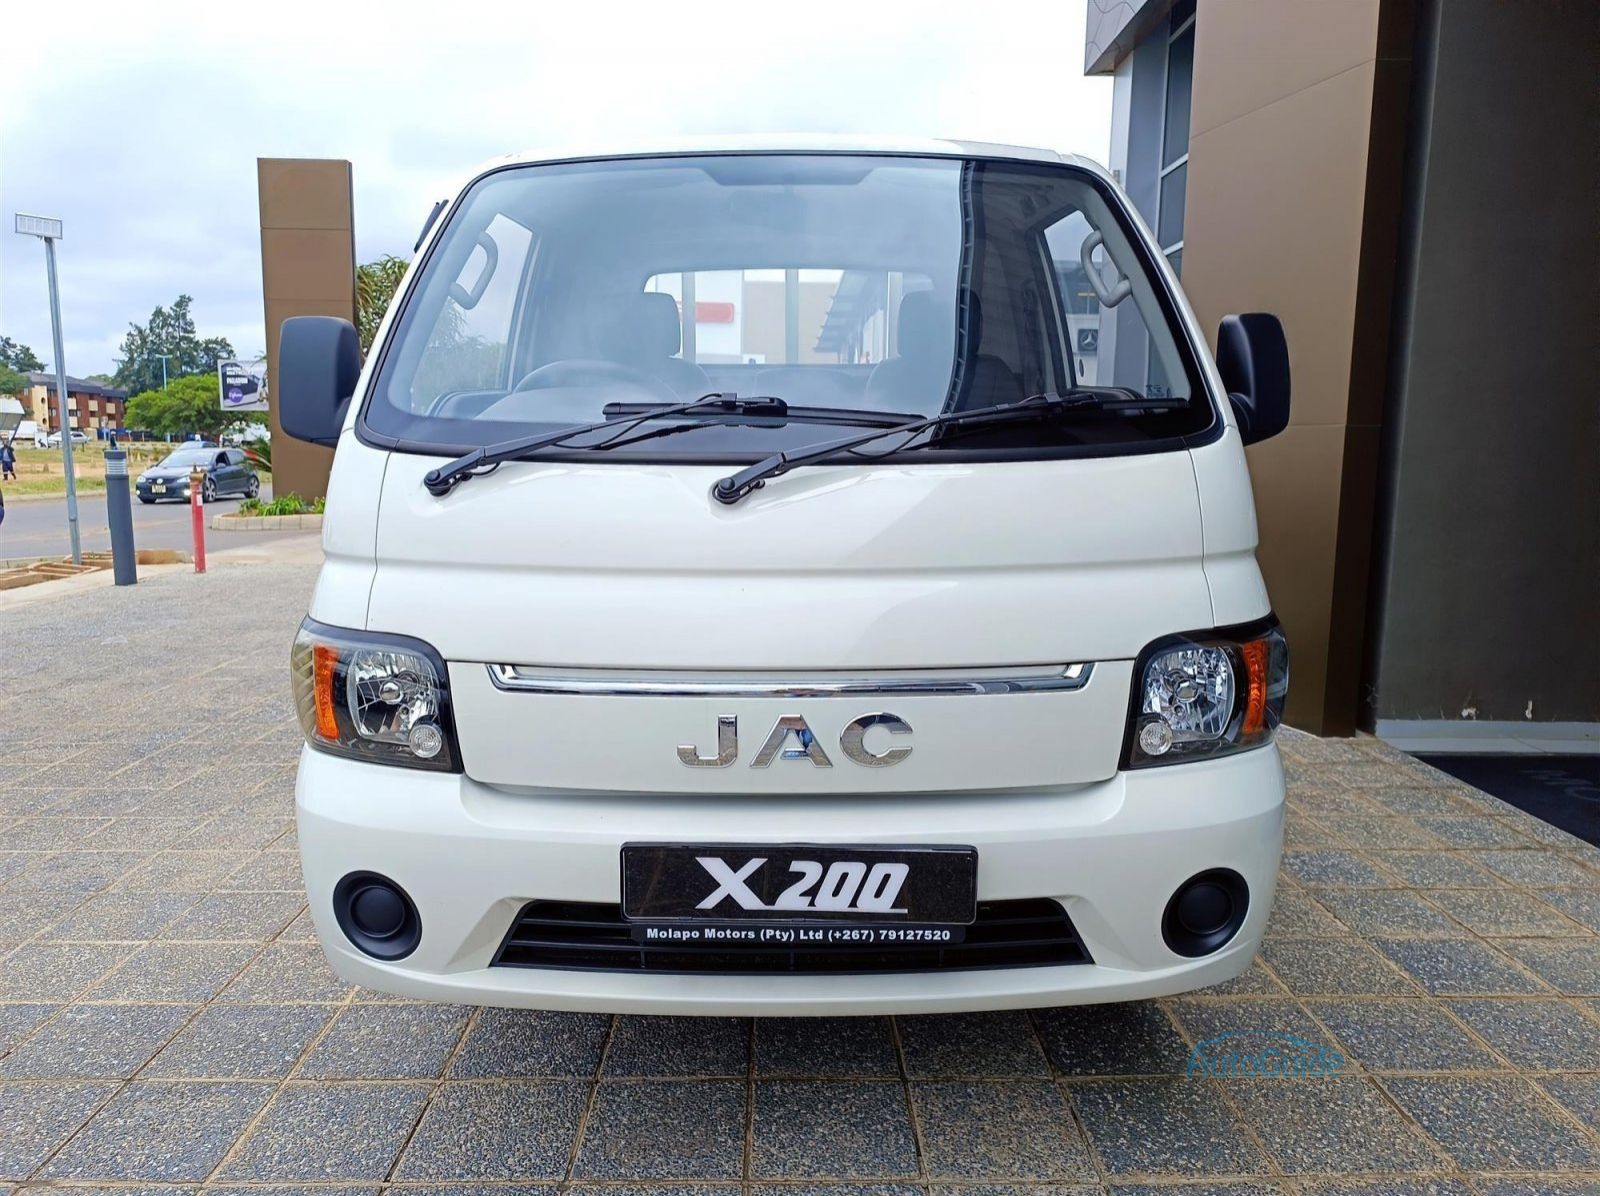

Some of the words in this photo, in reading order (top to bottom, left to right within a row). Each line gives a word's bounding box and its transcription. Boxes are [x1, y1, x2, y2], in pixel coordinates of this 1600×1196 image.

[678, 712, 913, 768] JAC
[646, 928, 700, 942] Molapo
[704, 928, 756, 941] Motors
[760, 928, 795, 943] (Pty)
[799, 928, 824, 941] Ltd
[828, 929, 875, 943] (+267)
[879, 930, 951, 942] 79127520
